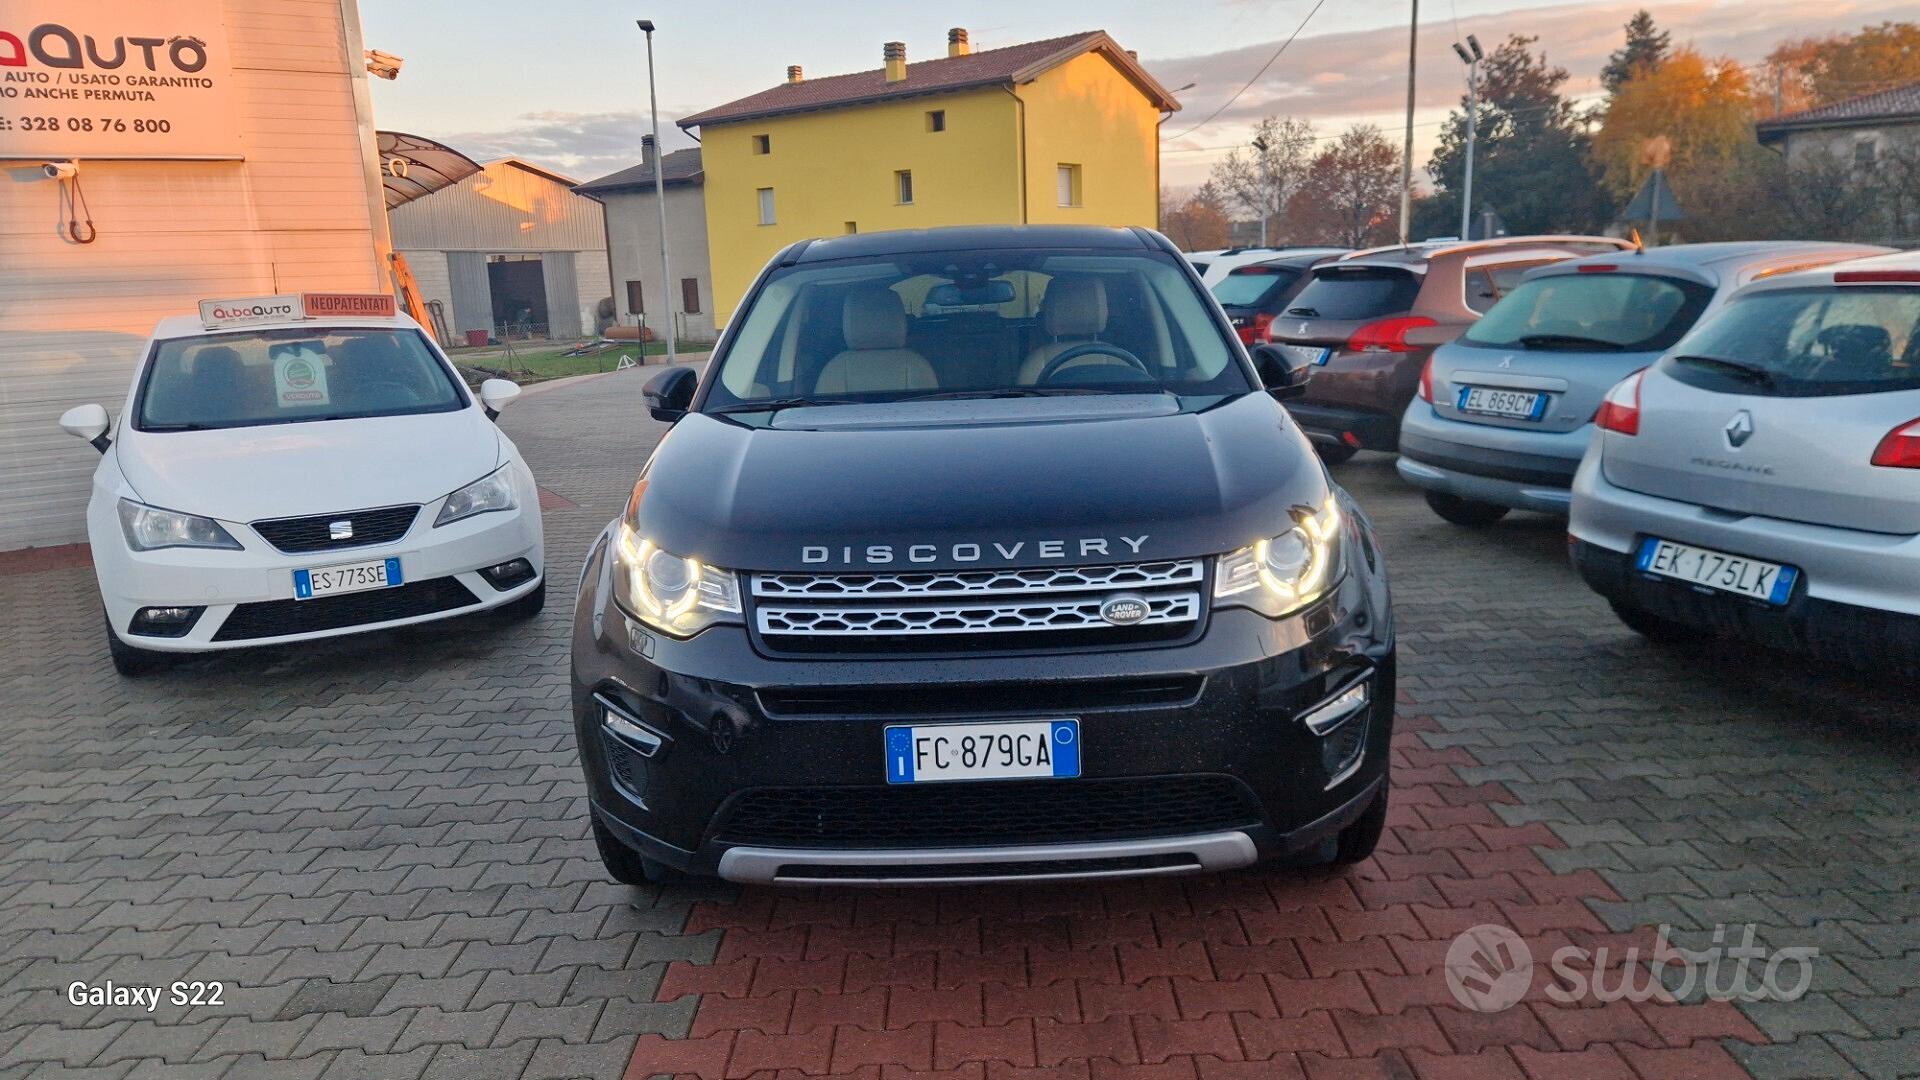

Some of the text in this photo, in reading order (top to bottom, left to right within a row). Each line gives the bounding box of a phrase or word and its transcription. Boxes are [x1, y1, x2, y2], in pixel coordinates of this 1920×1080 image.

[4, 71, 50, 83] AUTO
[69, 73, 120, 86] USATO
[126, 75, 213, 89] GARANTITO
[24, 87, 79, 99] ANCHE
[84, 89, 155, 101] PERMUTA
[20, 116, 60, 131] 328
[67, 117, 93, 132] 08
[100, 118, 126, 133] 76
[133, 118, 171, 133] 800
[311, 297, 389, 311] NEOPATENTATI
[1468, 390, 1534, 413] EL 869CM
[801, 535, 1149, 564] DISCOVERY
[311, 565, 387, 590] ES 773SE
[1654, 544, 1774, 595] EK 175LK
[1112, 603, 1134, 612] LAND
[1113, 609, 1141, 618] ROVER
[916, 733, 1050, 770] FC 879GA
